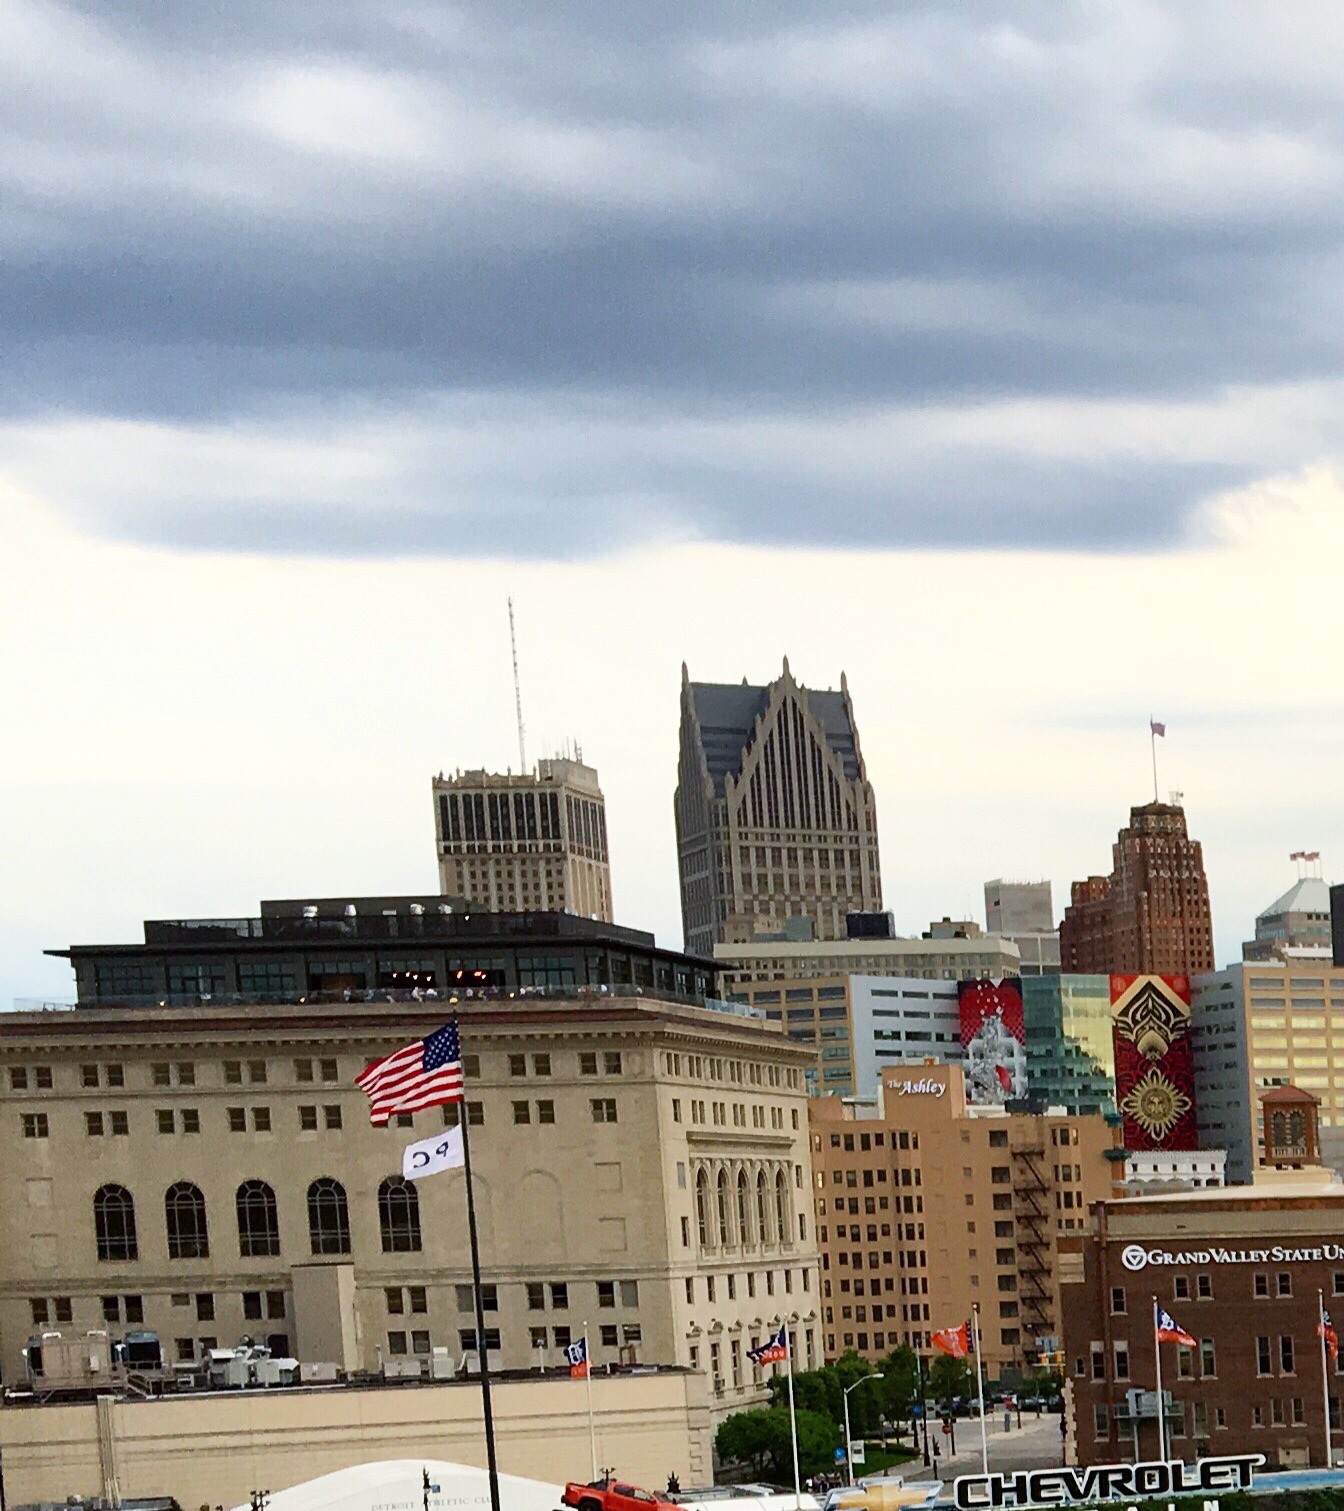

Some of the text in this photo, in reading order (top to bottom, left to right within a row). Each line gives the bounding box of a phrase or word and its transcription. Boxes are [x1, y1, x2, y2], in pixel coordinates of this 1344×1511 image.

[898, 1078, 946, 1097] Ashley
[1149, 1249, 1210, 1265] GRAND
[1209, 1247, 1269, 1264] VALLEY
[1270, 1246, 1323, 1262] STATE
[955, 1455, 1265, 1509] CHEVROLET
